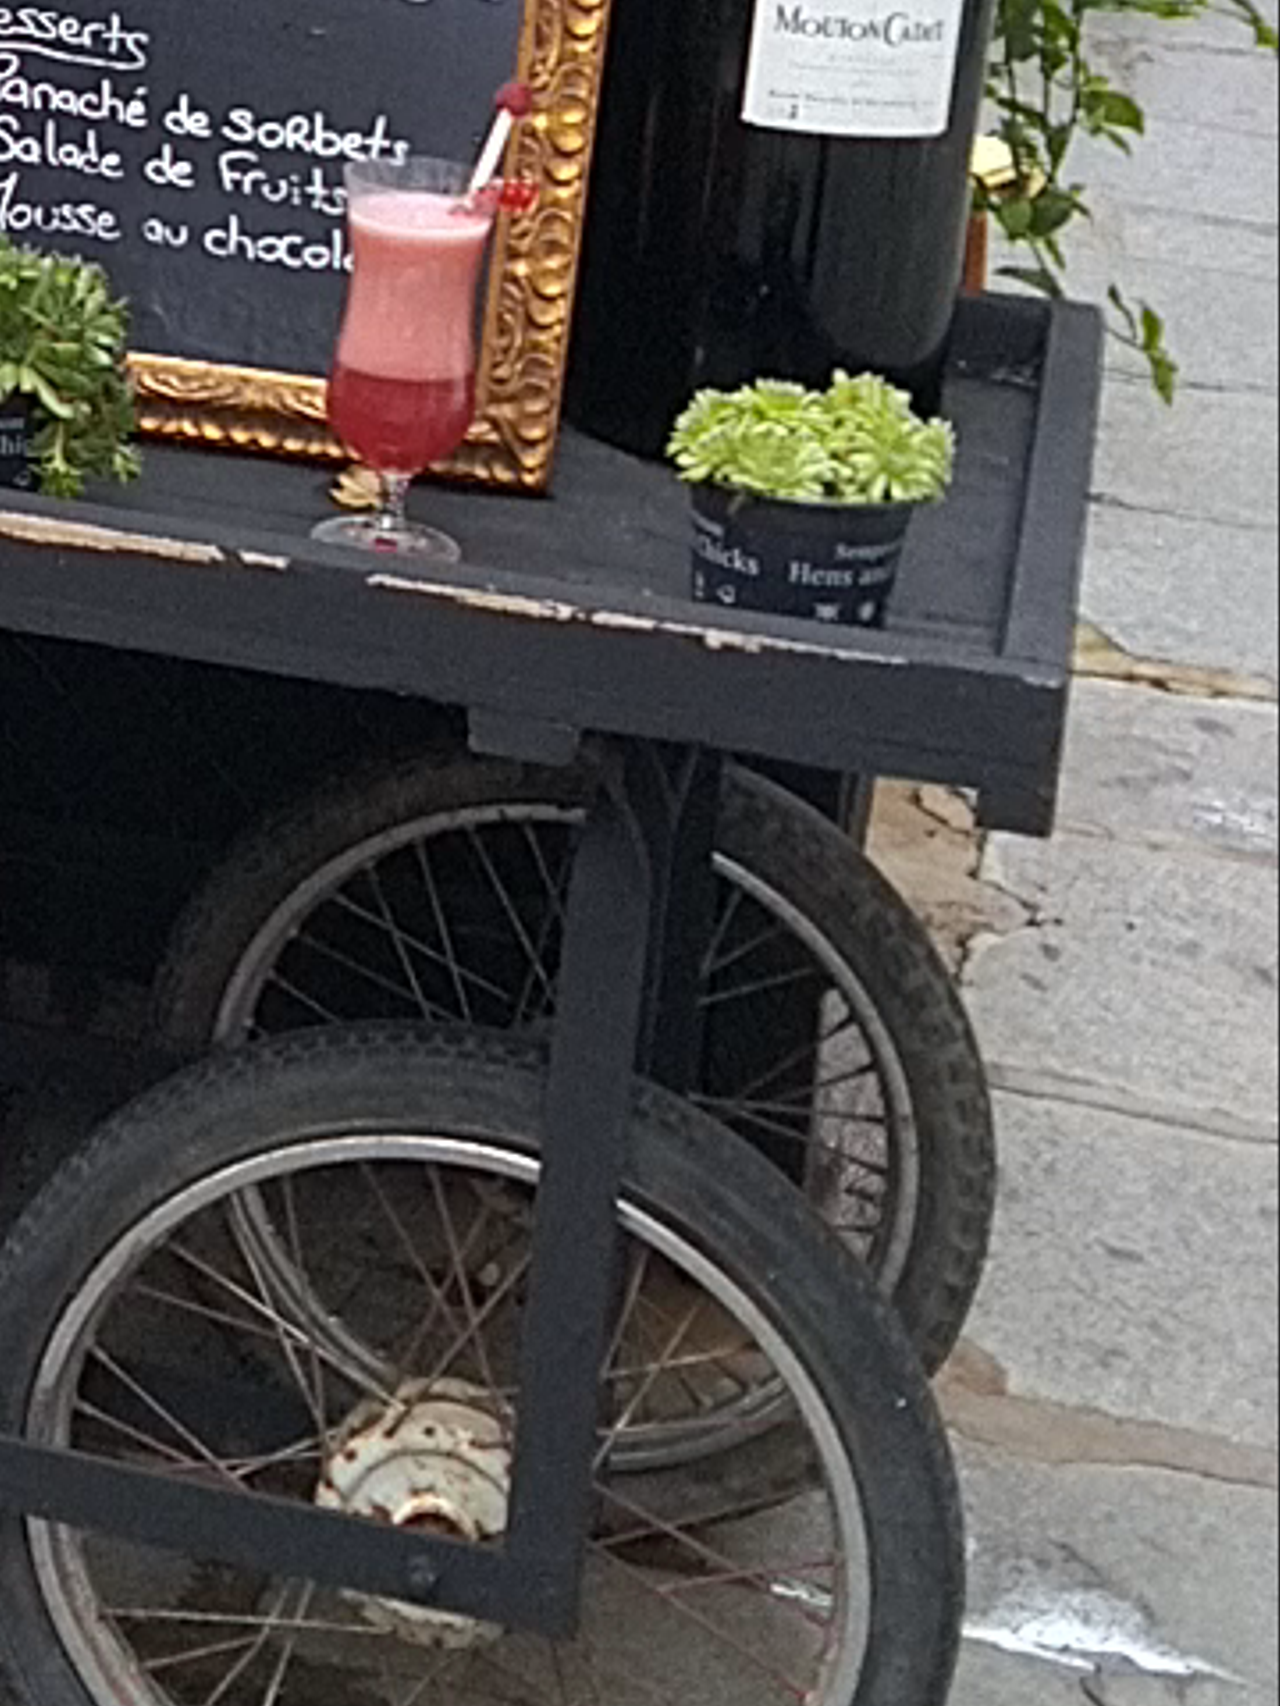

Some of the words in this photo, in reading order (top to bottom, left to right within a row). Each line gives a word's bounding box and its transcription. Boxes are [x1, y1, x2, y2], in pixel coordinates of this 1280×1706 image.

[164, 95, 210, 136] de
[144, 144, 194, 186] de
[143, 218, 187, 249] au
[789, 560, 854, 587] Hens
